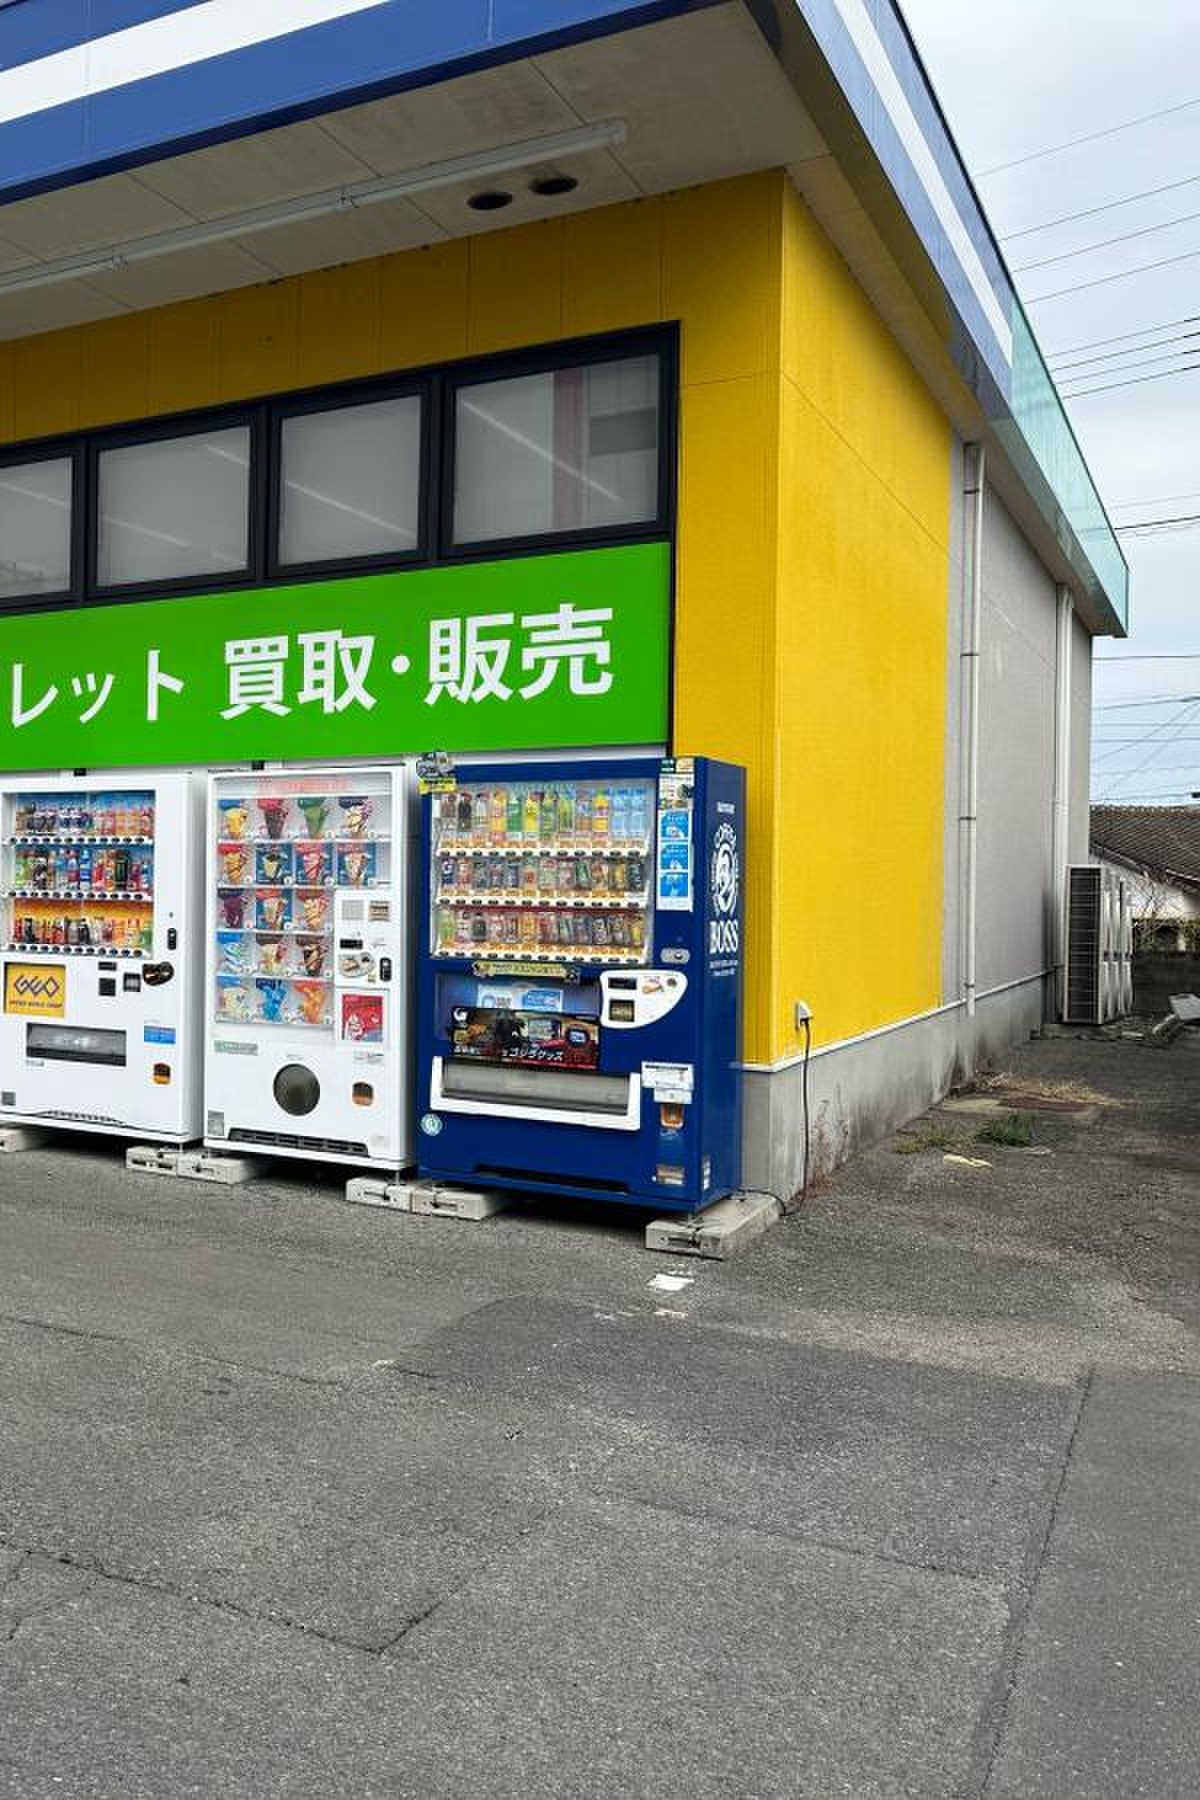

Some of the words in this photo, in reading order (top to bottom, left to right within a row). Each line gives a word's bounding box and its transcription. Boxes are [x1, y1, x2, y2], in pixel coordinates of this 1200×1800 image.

[220, 602, 614, 720] 買取・販売
[709, 919, 739, 954] BOSS
[14, 974, 60, 998] GEO
